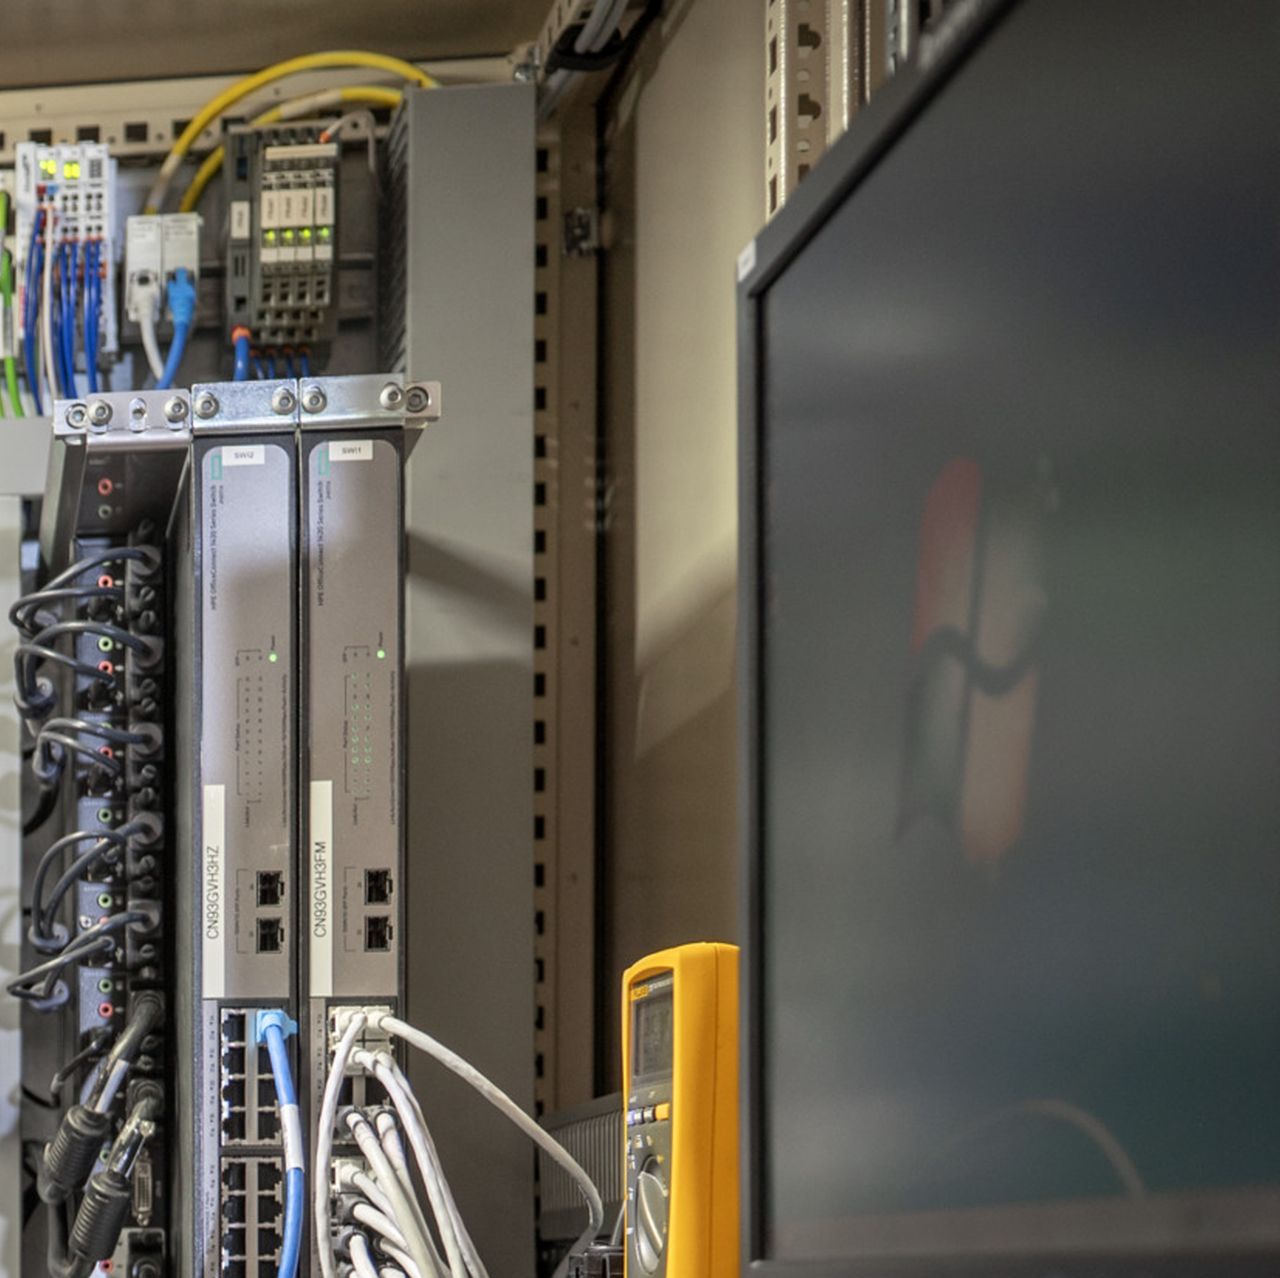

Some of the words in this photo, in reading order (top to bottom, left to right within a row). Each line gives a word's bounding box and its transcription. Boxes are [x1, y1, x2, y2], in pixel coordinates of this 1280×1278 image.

[209, 485, 218, 508] Switch
[209, 509, 218, 529] Series
[206, 845, 220, 940] CN93GVH3HZ
[313, 841, 327, 938] CN93GVH3FM
